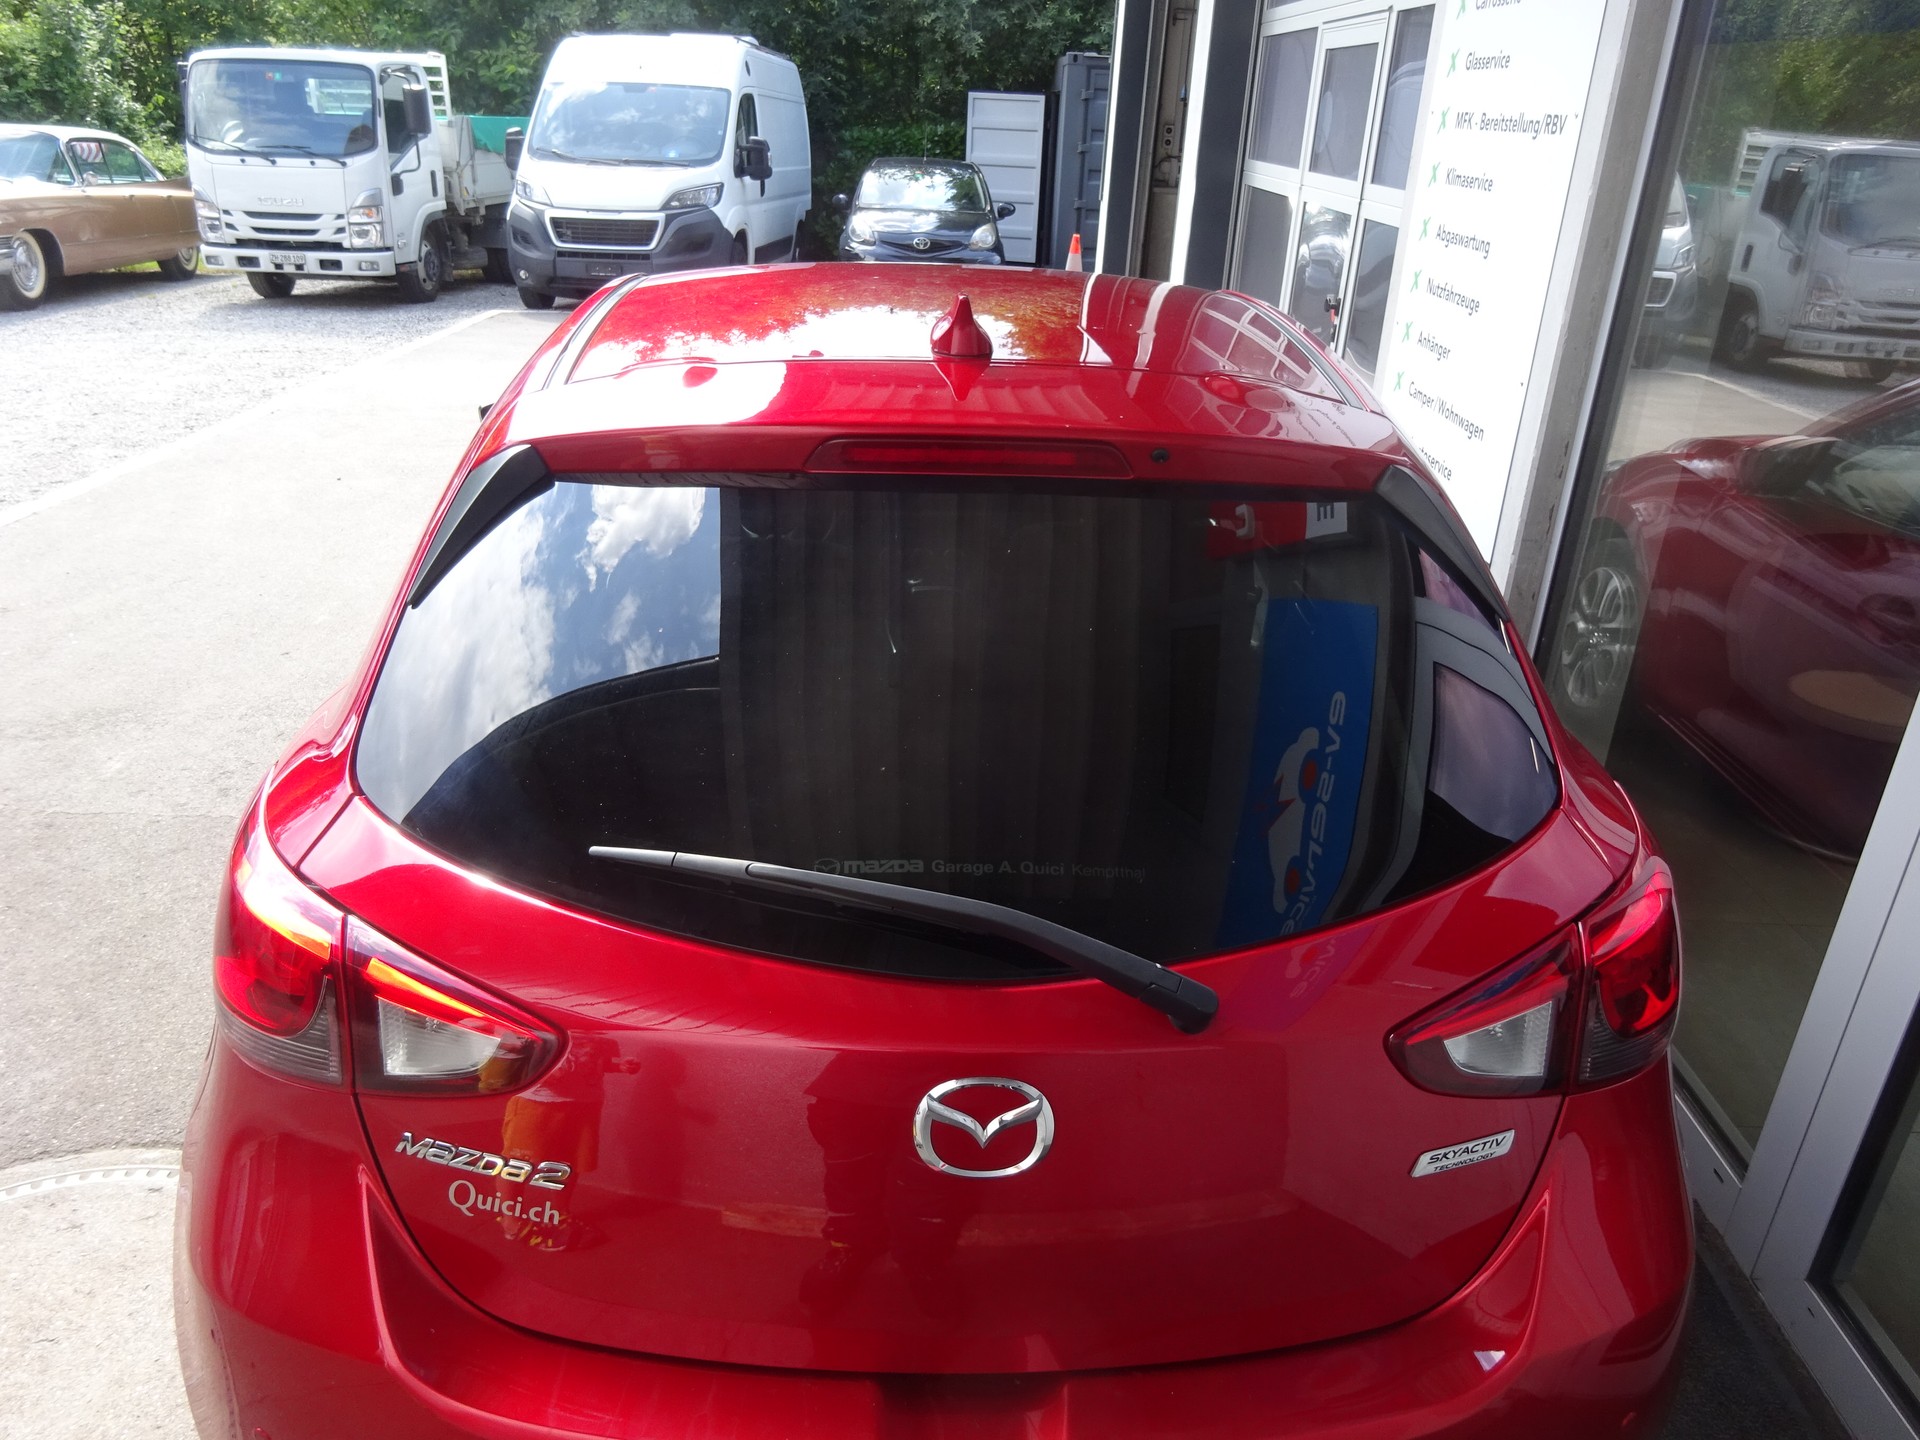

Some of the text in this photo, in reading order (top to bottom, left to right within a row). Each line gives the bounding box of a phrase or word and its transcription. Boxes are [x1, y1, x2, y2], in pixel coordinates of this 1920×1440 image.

[1465, 50, 1511, 71] Glasservice
[1454, 111, 1473, 129] MFK
[1445, 168, 1494, 193] Klimaservice
[257, 196, 304, 207] ISUZU
[1435, 224, 1491, 259] Abgaswartung
[1426, 277, 1480, 317] Nutzfahrzeuge
[1417, 331, 1451, 361] Anhänger
[931, 859, 994, 877] Garage
[998, 860, 1017, 874] A.
[1020, 860, 1065, 876] Quici
[1427, 1135, 1507, 1165] SKYACTIV
[1433, 1150, 1497, 1172] TECHNOLOGY
[448, 1179, 560, 1225] Quici.ch
